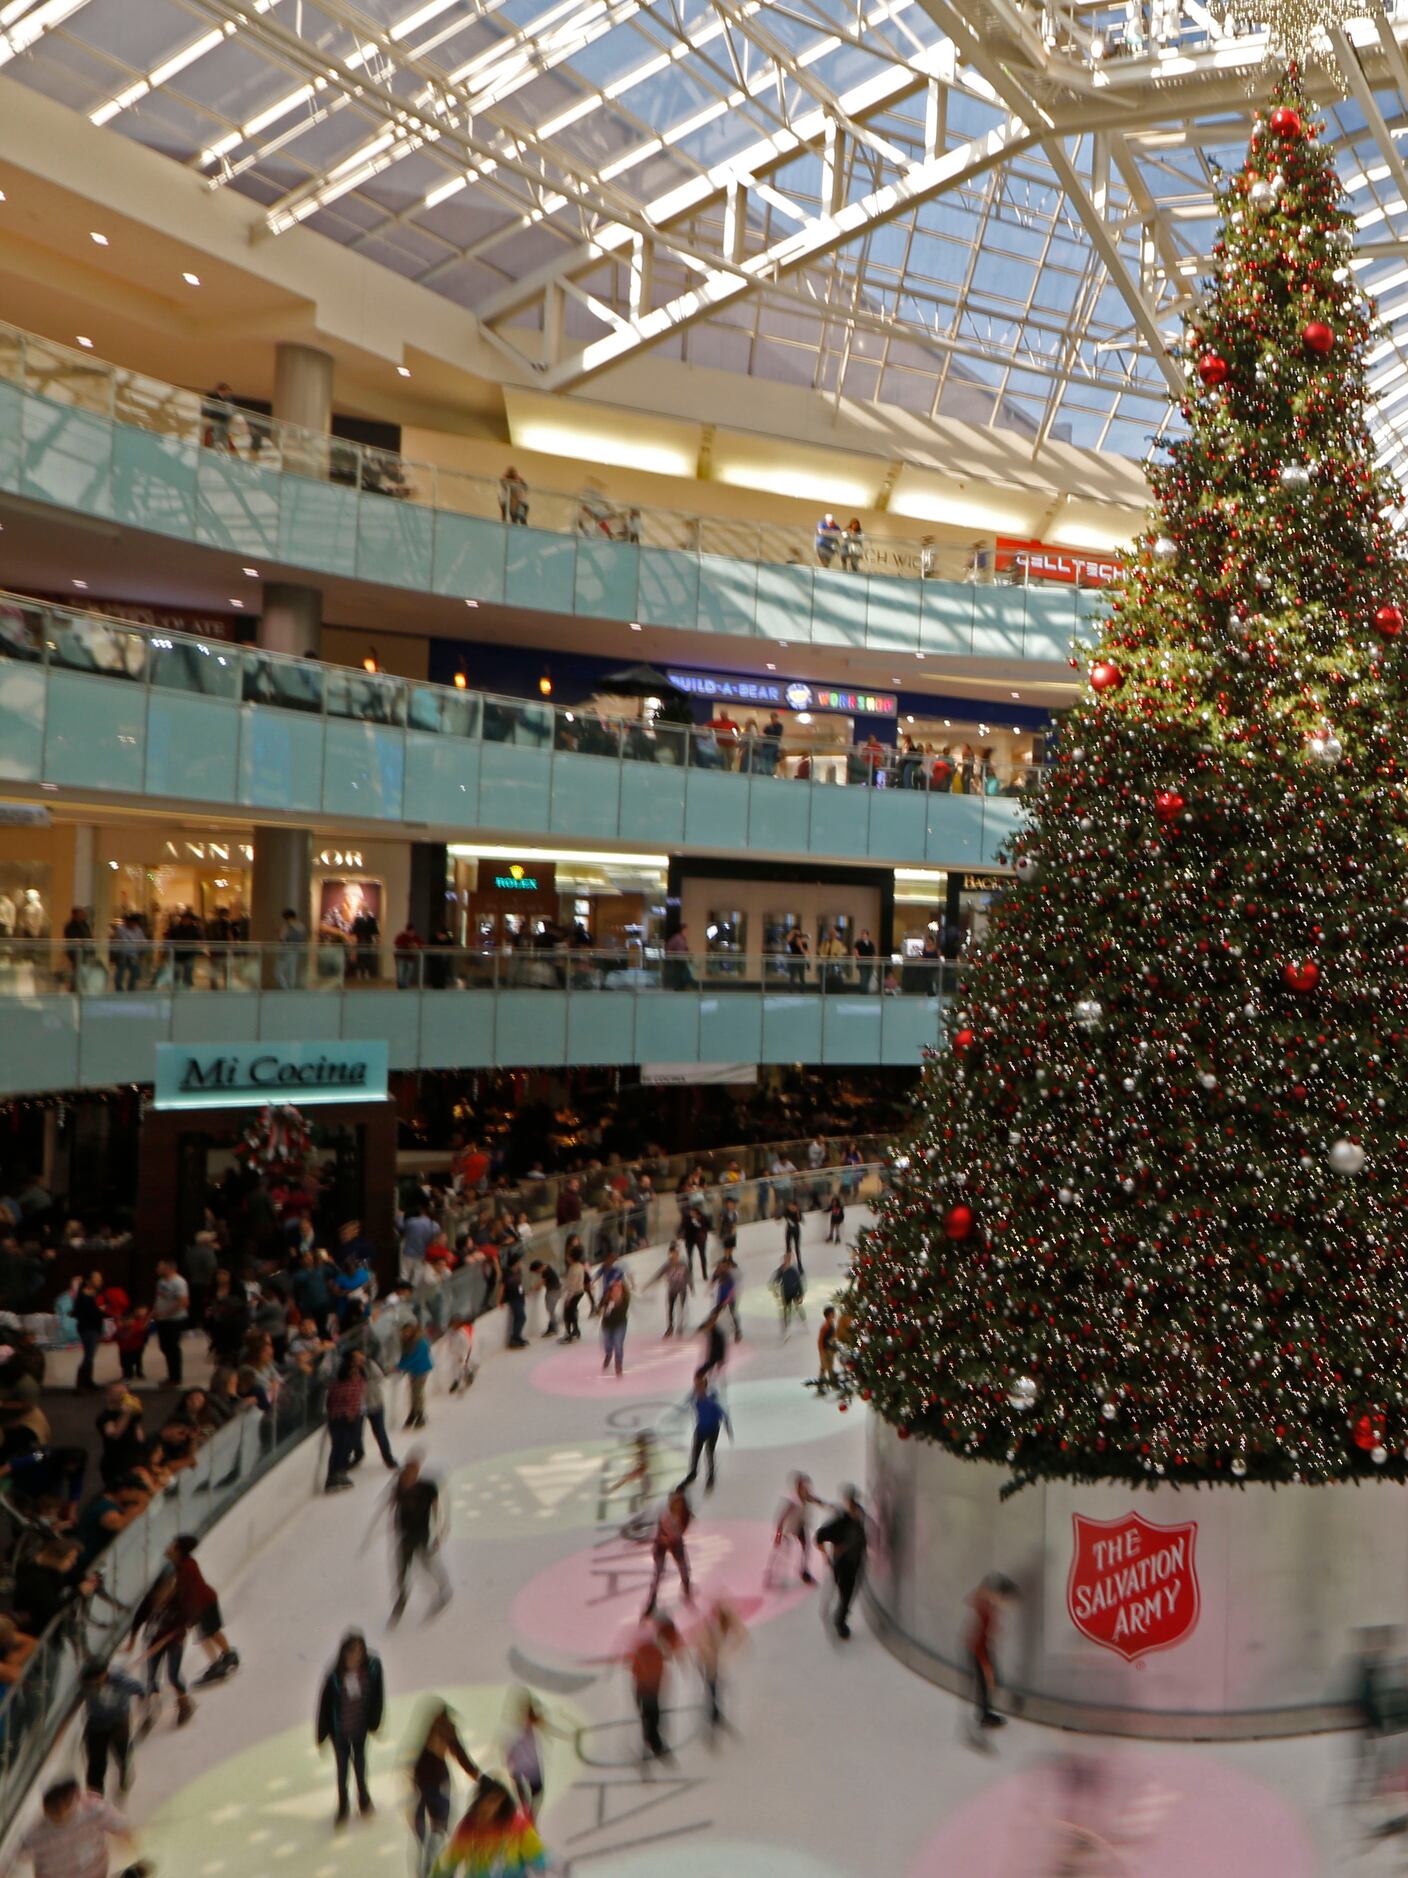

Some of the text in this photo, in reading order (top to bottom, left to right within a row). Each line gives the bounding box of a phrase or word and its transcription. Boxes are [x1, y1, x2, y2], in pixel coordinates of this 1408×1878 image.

[817, 691, 894, 713] WORKSHOP
[496, 877, 538, 890] ROLEX
[183, 1055, 367, 1085] Mi Cocina
[1092, 1528, 1143, 1571] THE
[1075, 1537, 1185, 1619] SALVATION
[1112, 1578, 1181, 1642] ARMY
